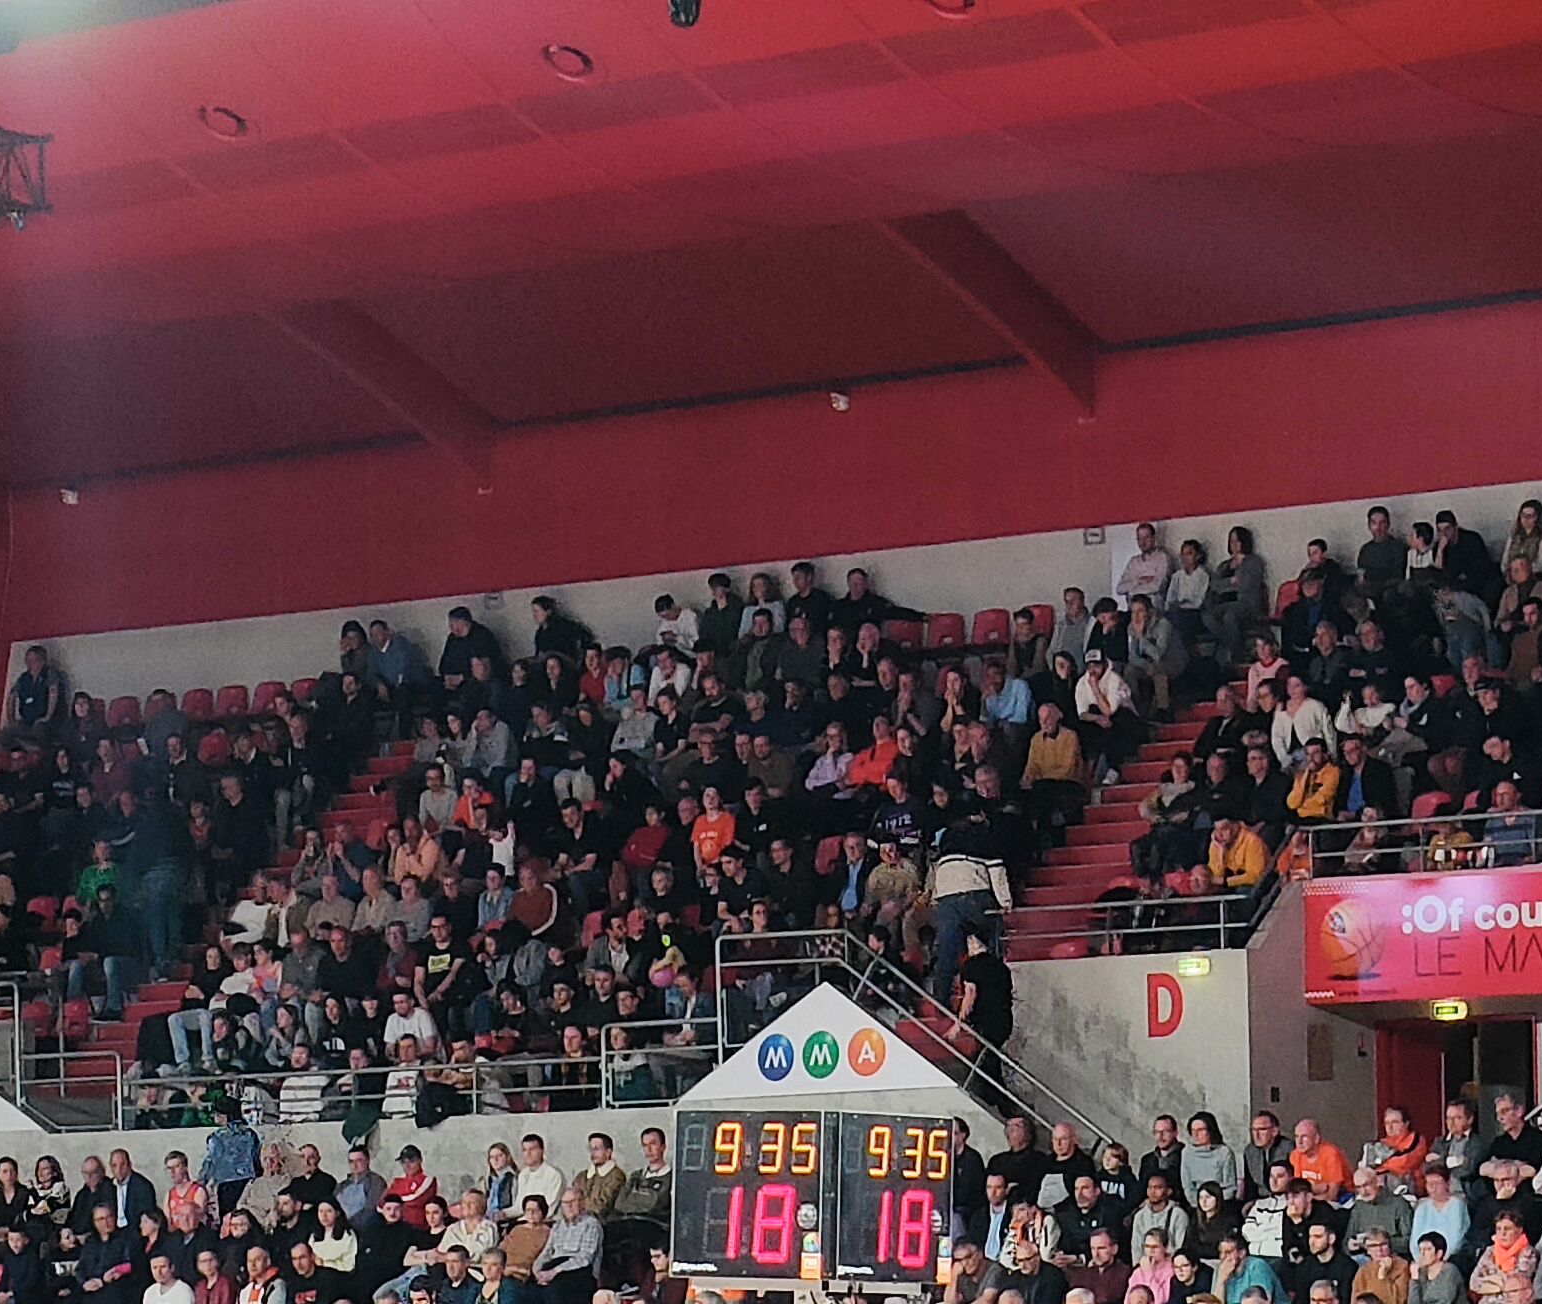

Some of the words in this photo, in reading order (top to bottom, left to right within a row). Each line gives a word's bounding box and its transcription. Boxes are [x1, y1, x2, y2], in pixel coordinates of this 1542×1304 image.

[1412, 935, 1464, 977] LE
[1147, 973, 1183, 1037] D
[762, 1036, 880, 1074] MMA
[725, 1184, 797, 1264] 18
[877, 1189, 935, 1269] 18
